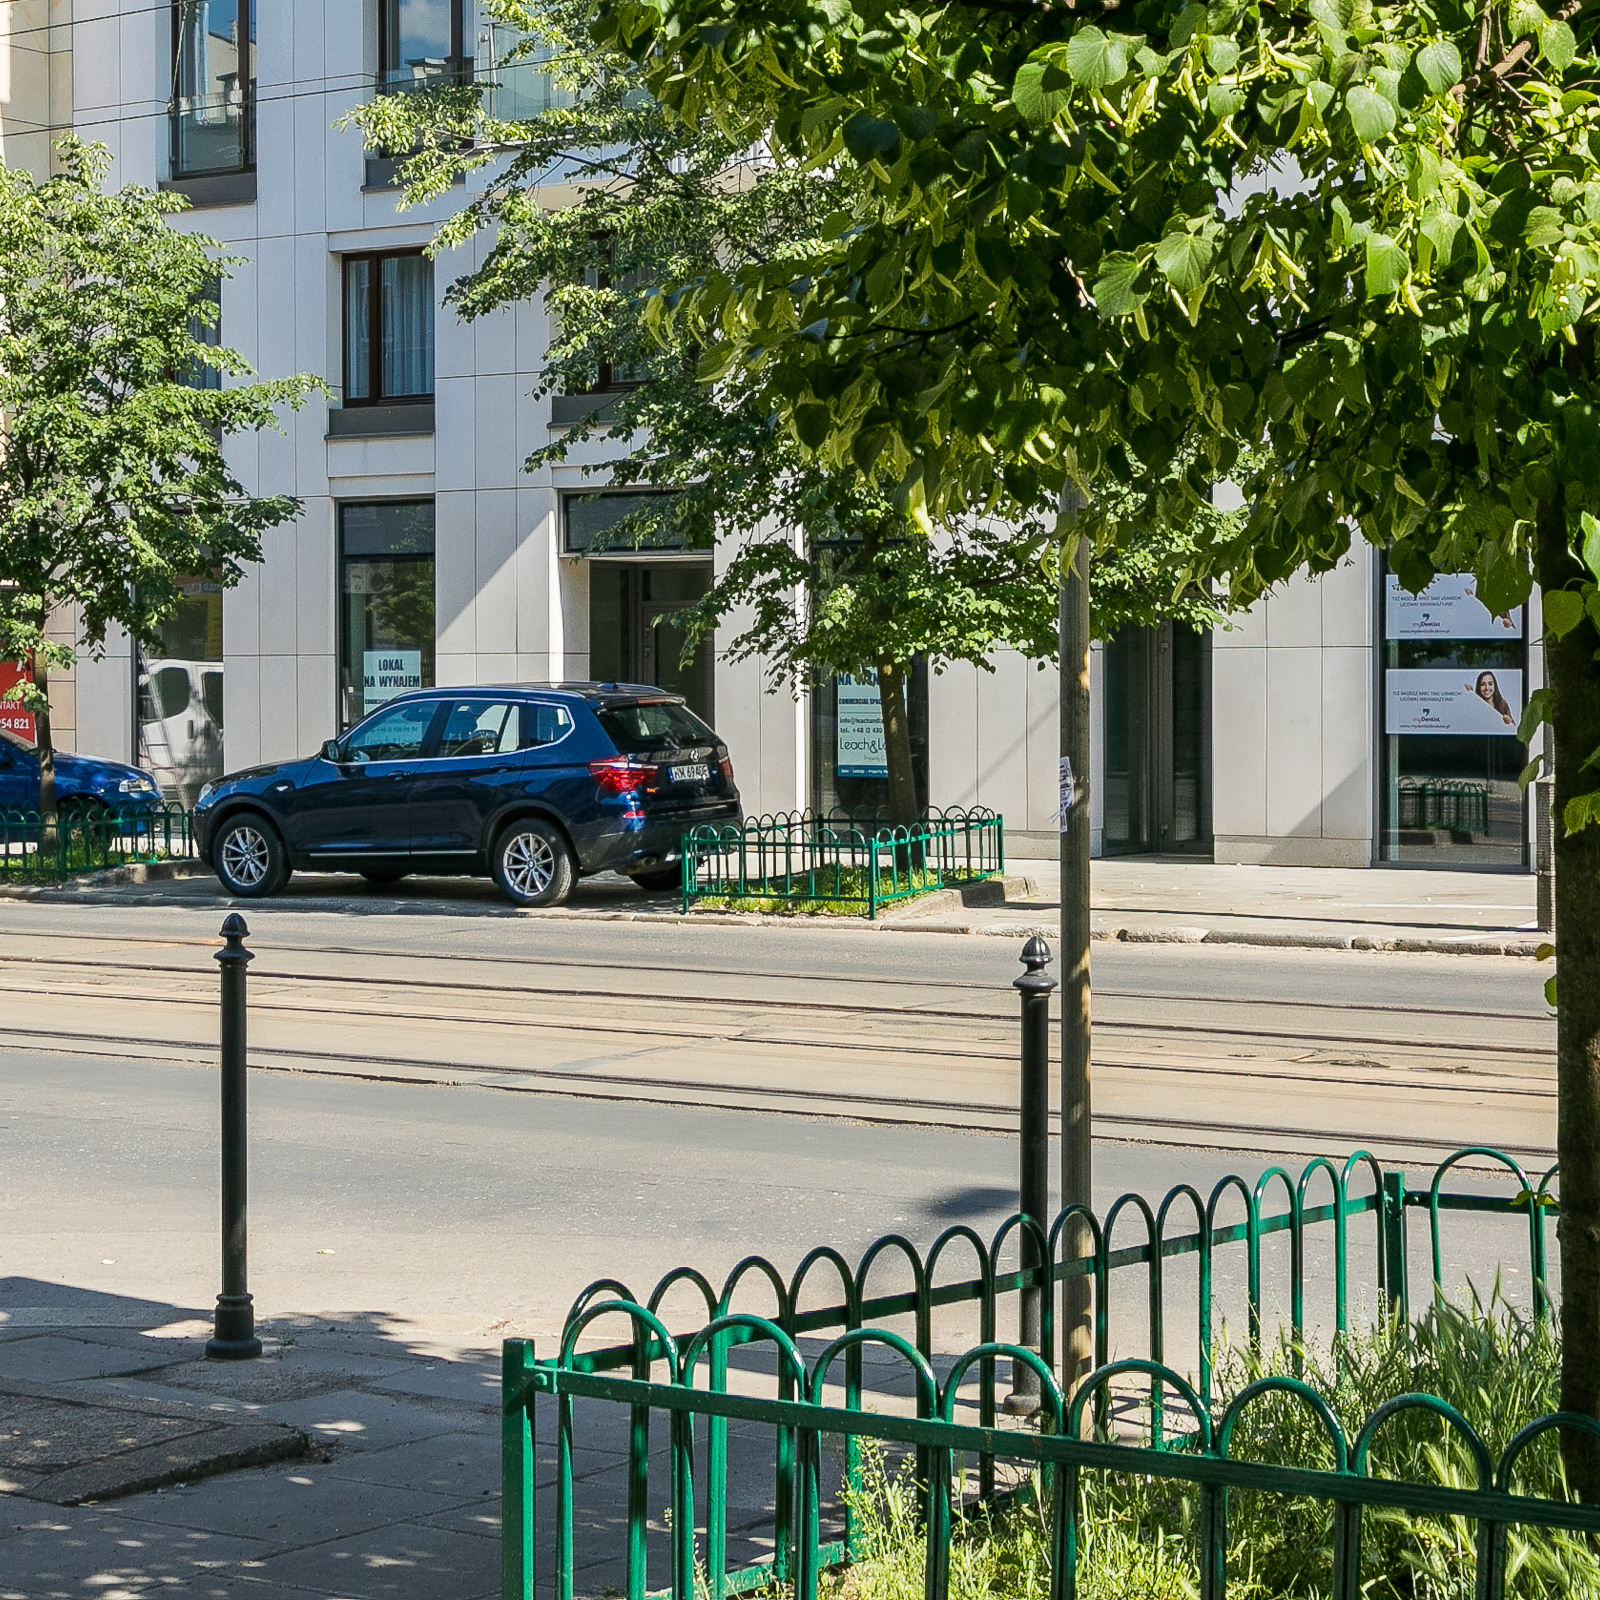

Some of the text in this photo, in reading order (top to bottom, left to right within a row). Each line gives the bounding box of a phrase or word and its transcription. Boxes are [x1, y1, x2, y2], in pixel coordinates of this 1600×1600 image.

[378, 659, 404, 671] LOKAL
[364, 675, 420, 687] NA WYNAJEM
[13, 718, 30, 729] 821
